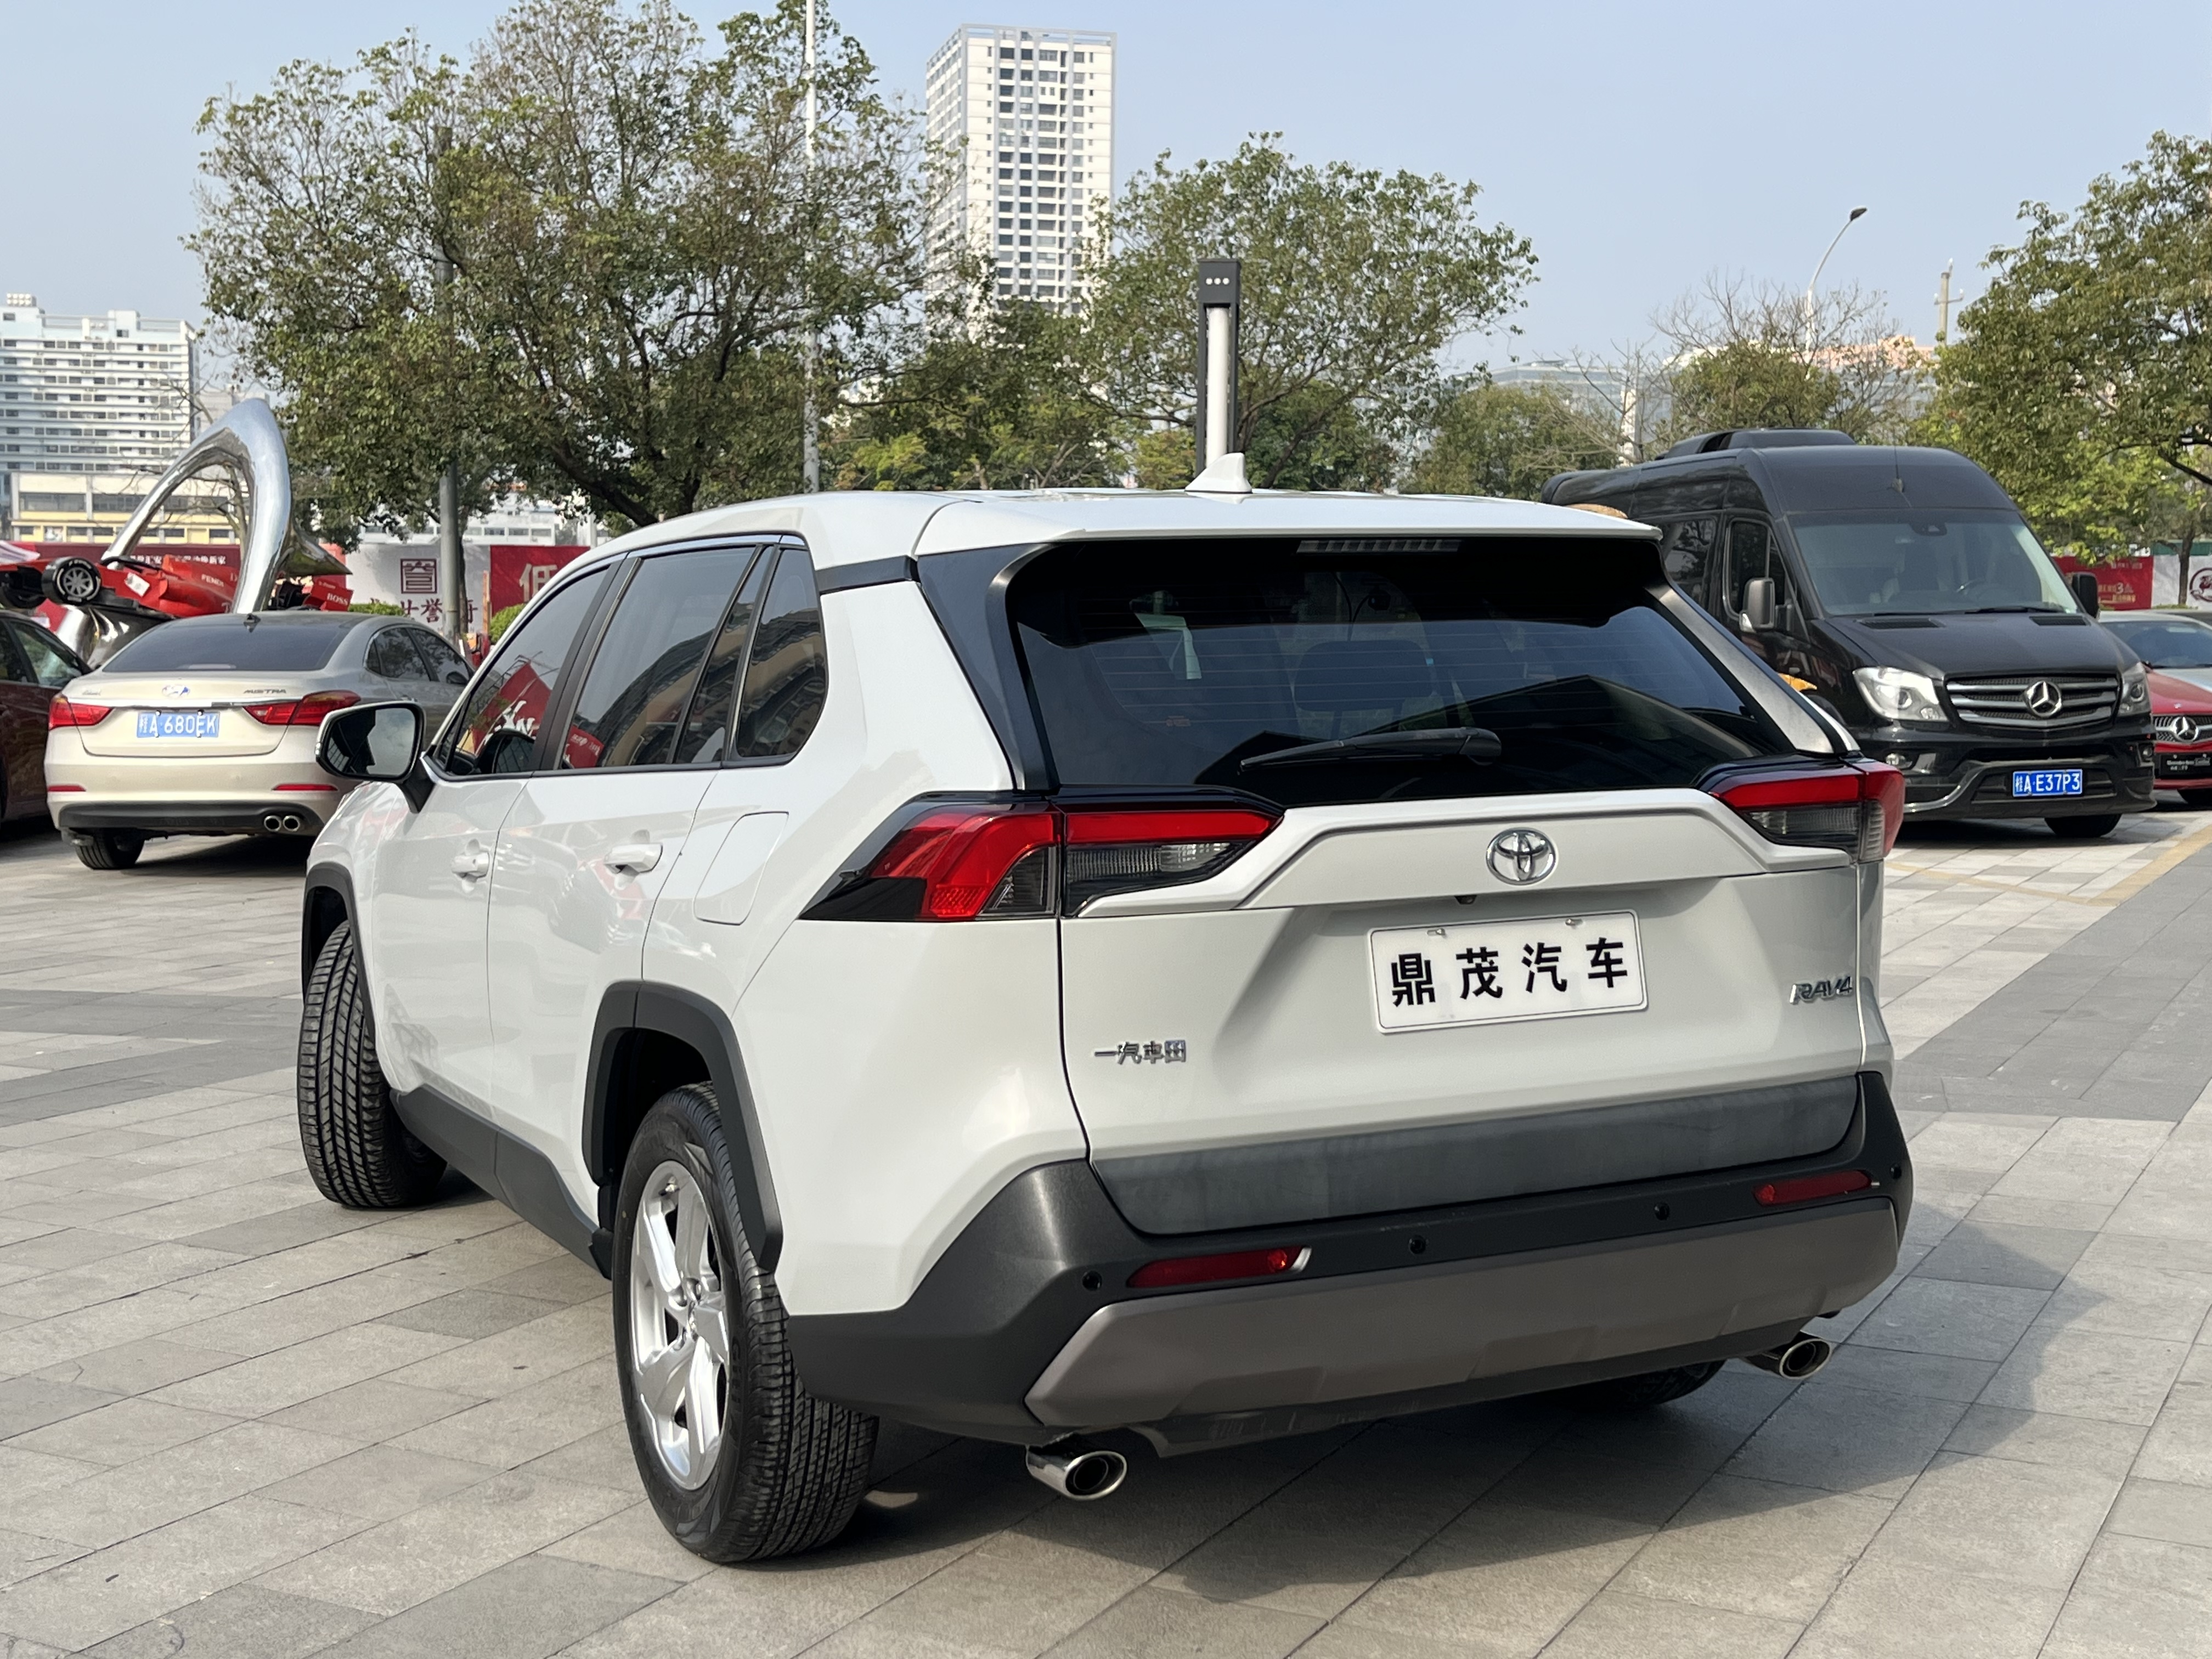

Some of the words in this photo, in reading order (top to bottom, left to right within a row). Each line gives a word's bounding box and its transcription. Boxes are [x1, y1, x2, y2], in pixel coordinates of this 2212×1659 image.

[326, 592, 348, 606] BOSS
[1391, 936, 1628, 1007] 鼎茂汽车
[1790, 975, 1853, 1004] RAV4
